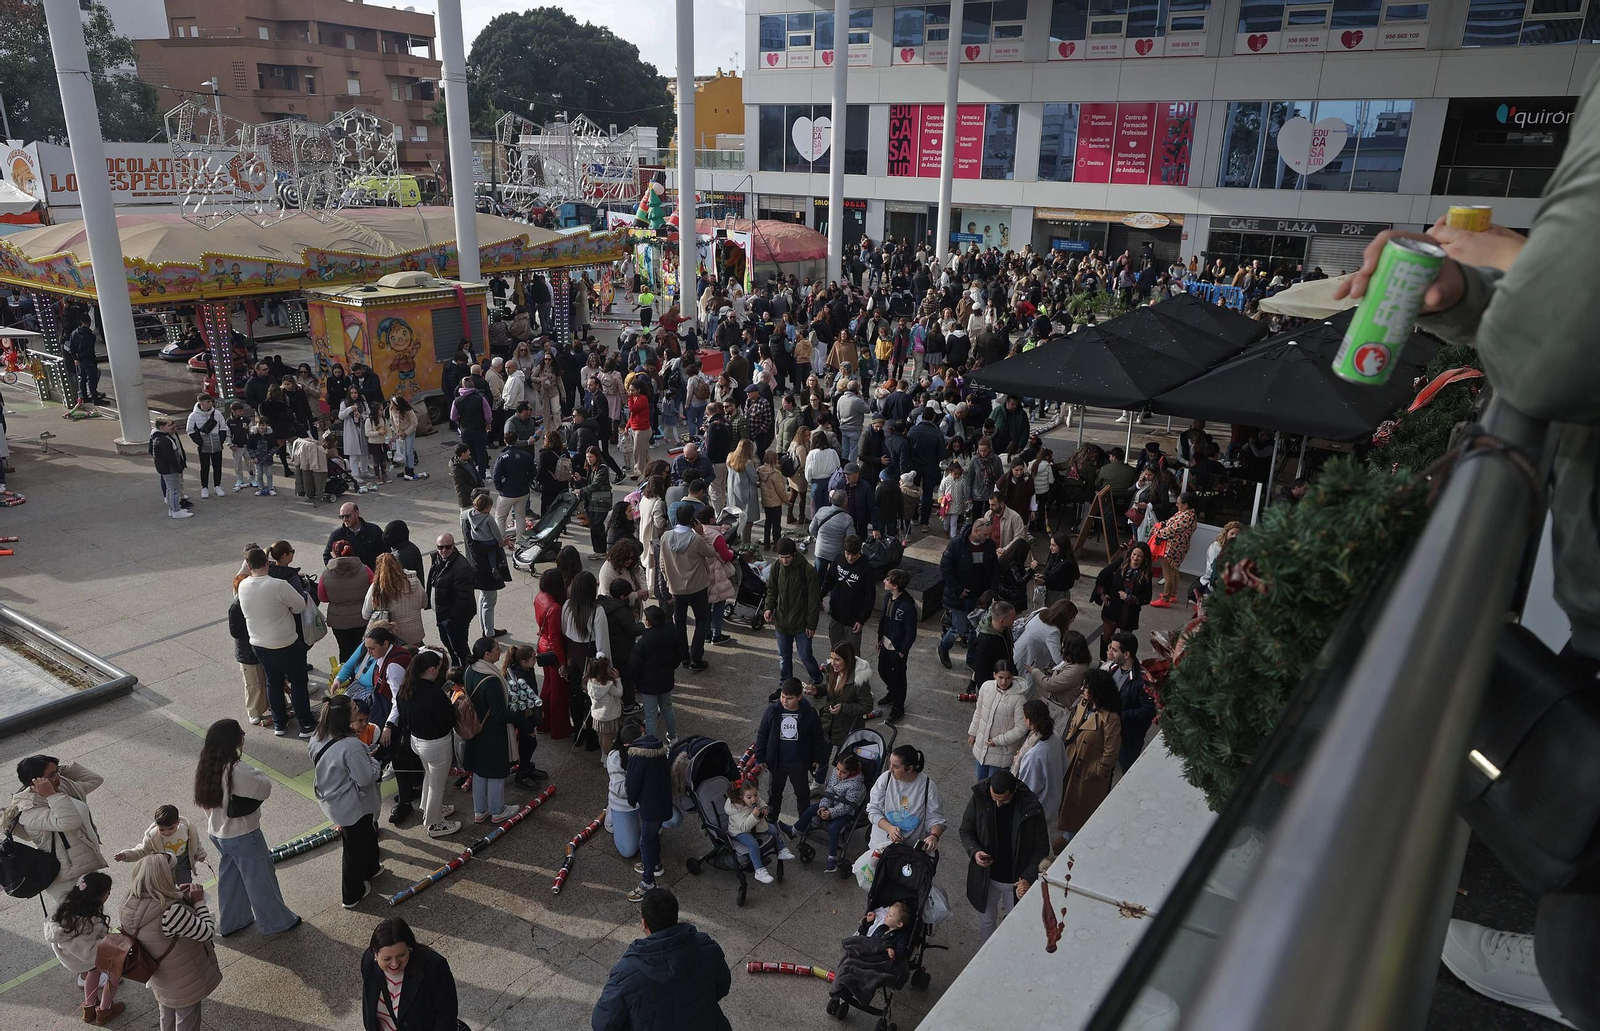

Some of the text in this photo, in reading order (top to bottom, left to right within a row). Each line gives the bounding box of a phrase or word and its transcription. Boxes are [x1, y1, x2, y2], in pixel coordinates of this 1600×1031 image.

[891, 105, 911, 118] EDU
[890, 119, 911, 139] CA
[1312, 137, 1326, 146] CA
[889, 140, 910, 160] SA
[1310, 148, 1324, 157] SA
[888, 162, 910, 176] LUD
[50, 174, 78, 192] LO
[1229, 219, 1365, 234] CAFE PLAZA PDF
